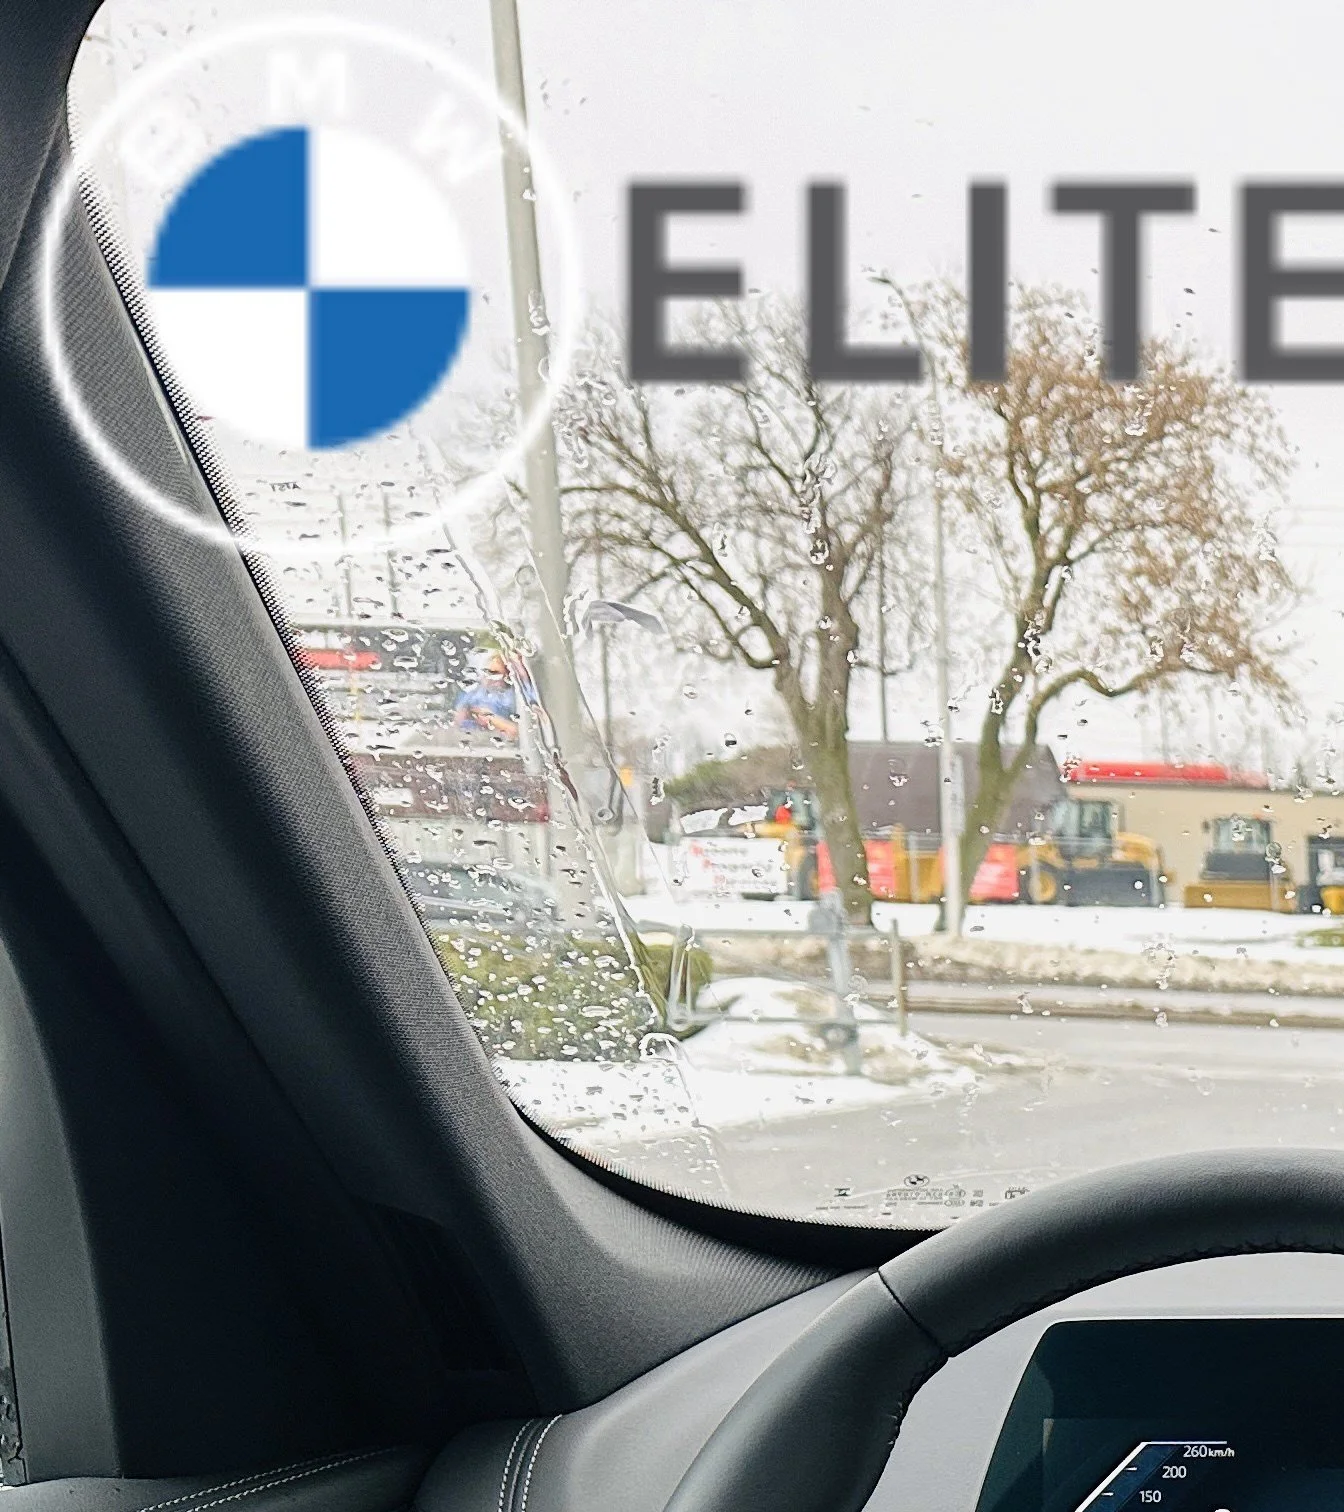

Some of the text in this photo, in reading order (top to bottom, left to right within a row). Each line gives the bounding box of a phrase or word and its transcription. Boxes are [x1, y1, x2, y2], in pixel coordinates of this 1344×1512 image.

[1183, 1445, 1235, 1458] 260 km/h
[1162, 1466, 1187, 1479] 200
[1139, 1490, 1162, 1503] 150
